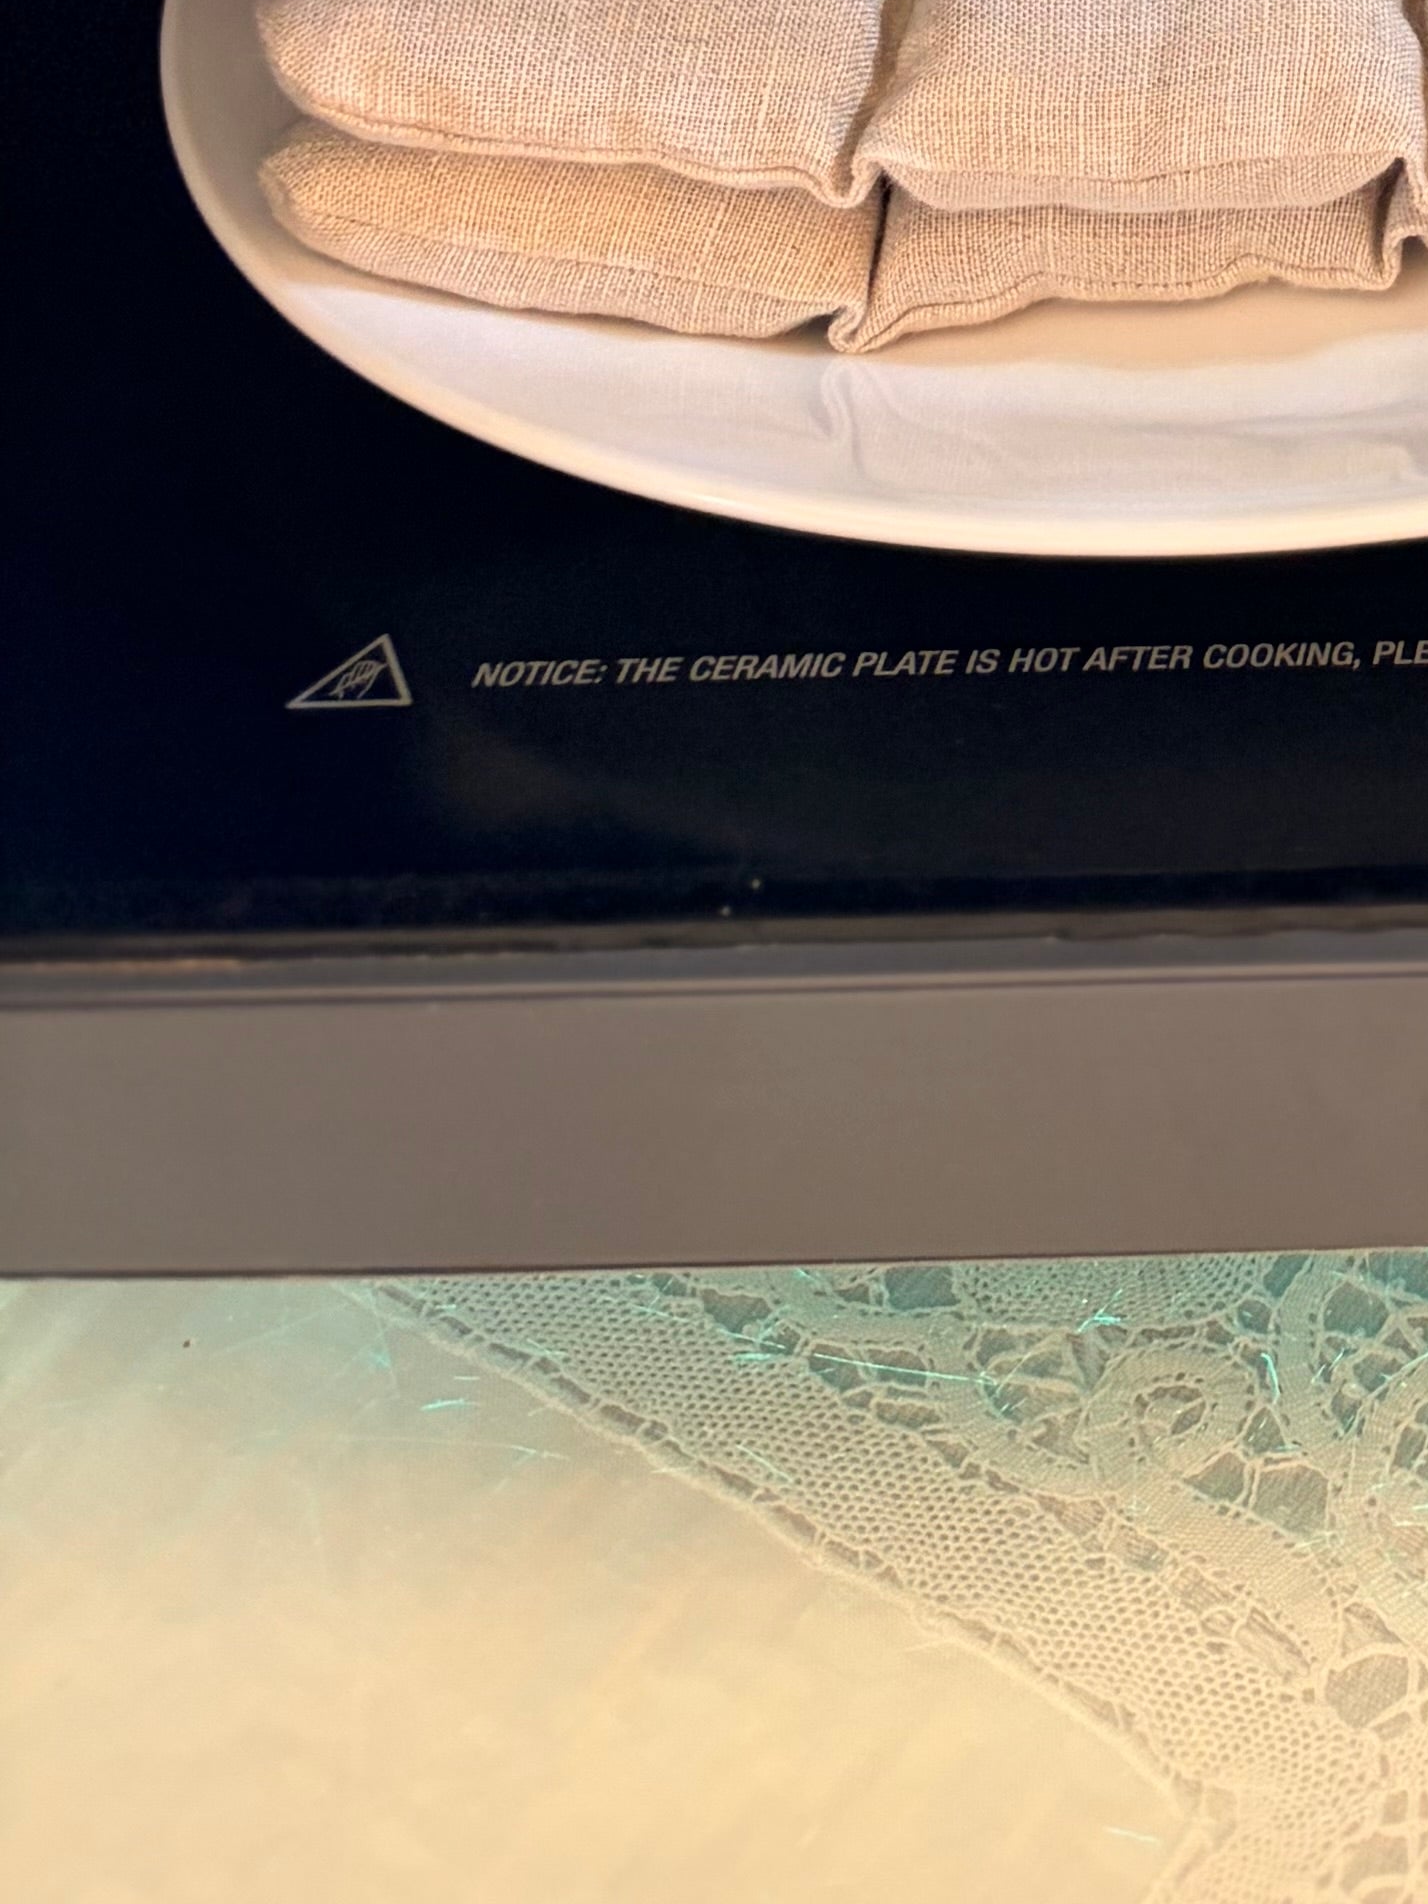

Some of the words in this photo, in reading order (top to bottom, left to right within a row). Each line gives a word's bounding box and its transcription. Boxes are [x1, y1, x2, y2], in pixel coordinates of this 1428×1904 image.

[470, 659, 608, 687] NOTICE:
[616, 656, 684, 684] THE
[689, 652, 846, 682] CERAMIC
[852, 649, 959, 677] PLATE
[965, 648, 1001, 674] IS
[1008, 647, 1081, 673] HOT
[1082, 645, 1193, 671] AFTER
[1203, 641, 1361, 670] COOKING,
